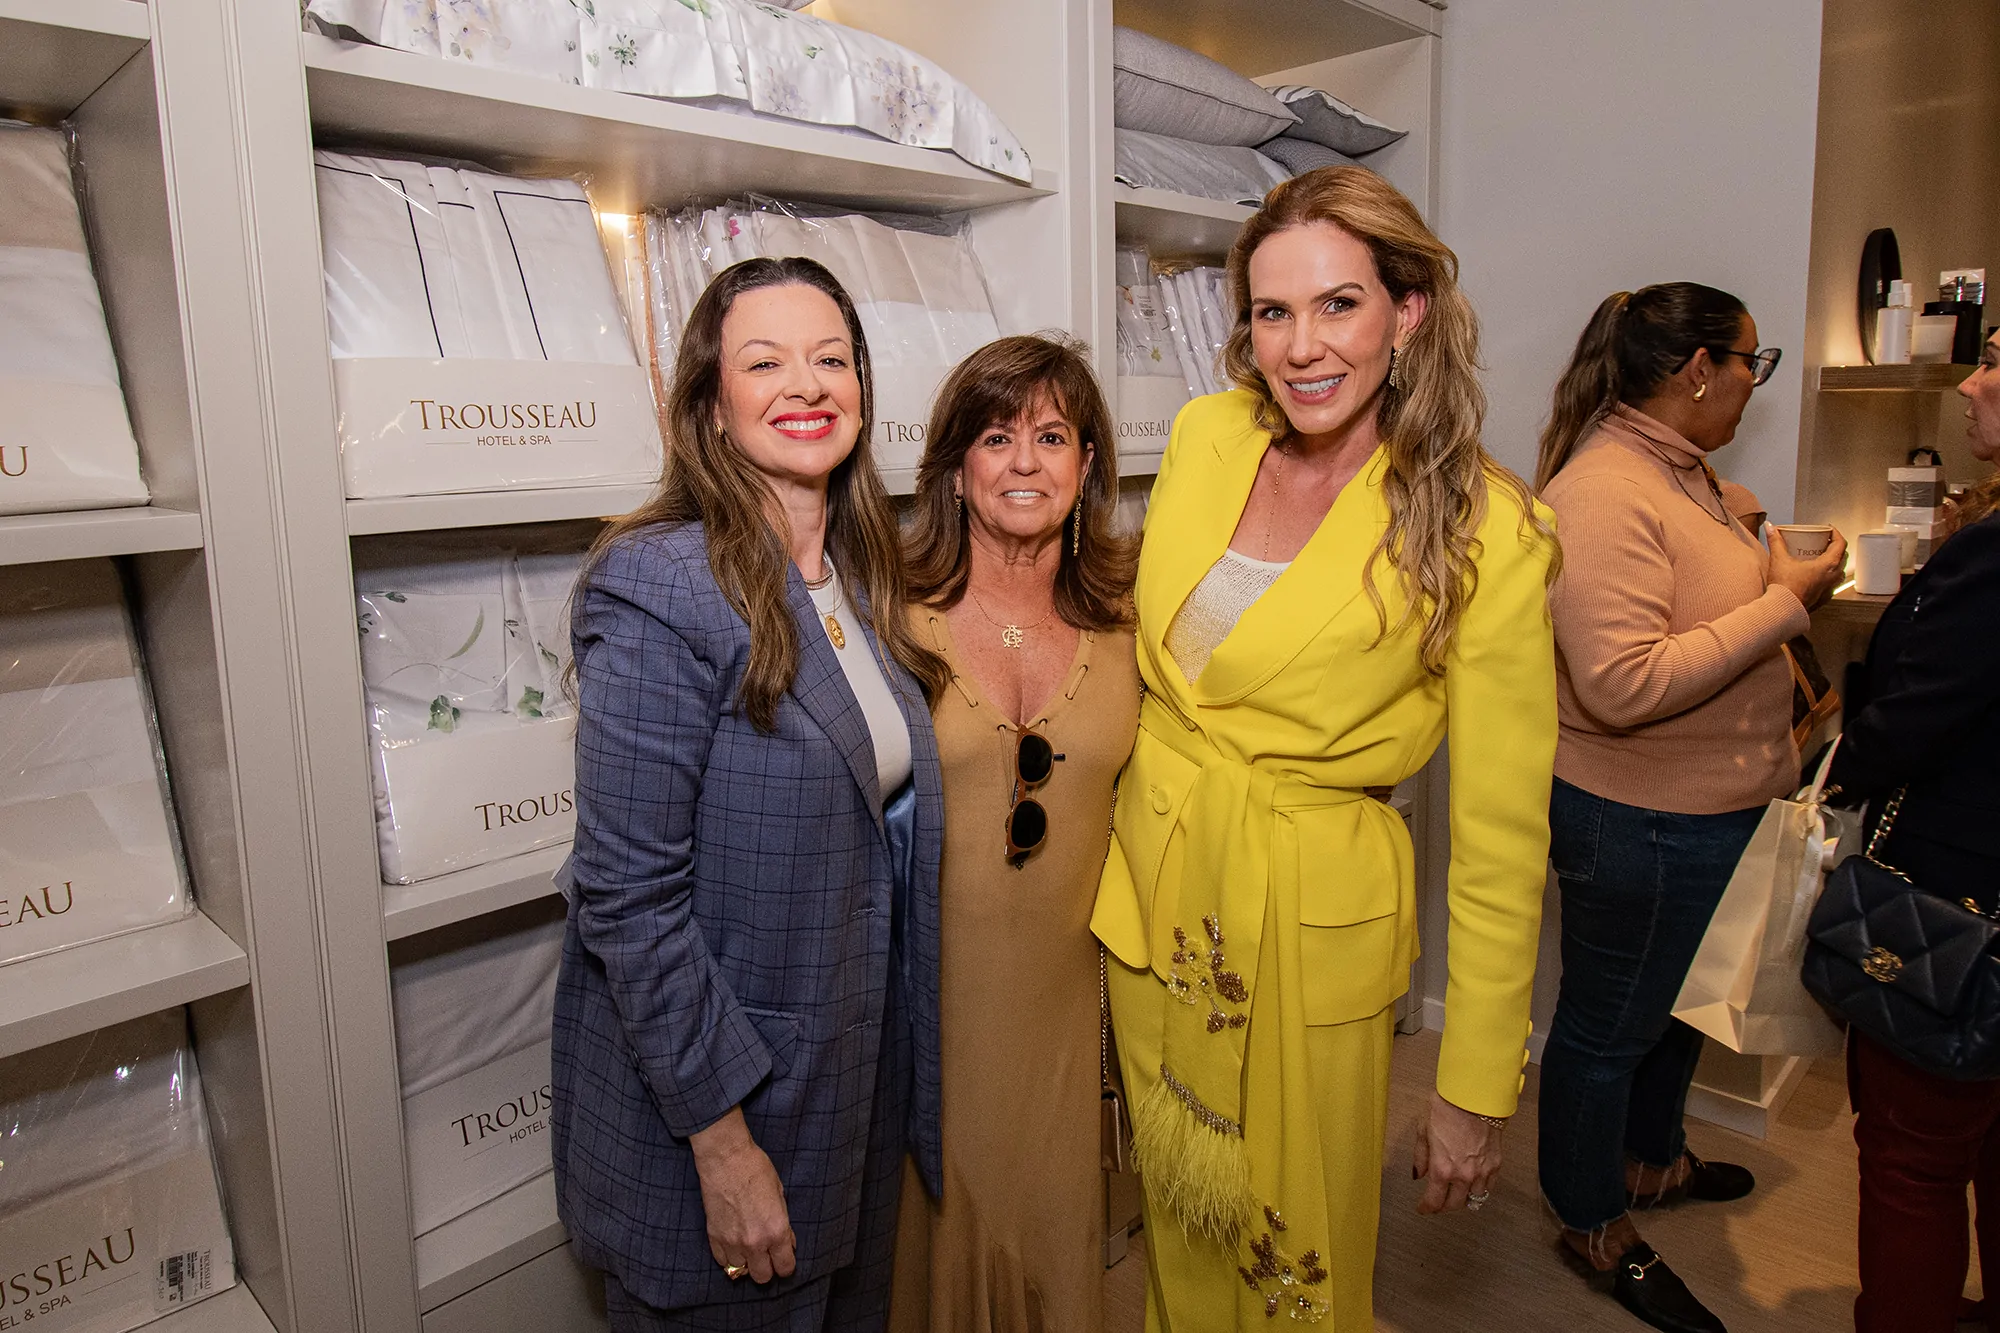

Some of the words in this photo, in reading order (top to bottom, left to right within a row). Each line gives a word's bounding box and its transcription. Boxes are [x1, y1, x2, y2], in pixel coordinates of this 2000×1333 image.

[410, 399, 597, 430] TROUSSEAU
[476, 435, 516, 447] HOTEL
[518, 436, 527, 446] &
[529, 434, 552, 446] SPA
[880, 421, 928, 443] TRO
[1117, 419, 1171, 438] OUSSEAU
[474, 789, 573, 832] TROUS
[509, 1119, 547, 1144] HOTEL
[24, 1308, 35, 1321] &
[39, 1294, 72, 1315] SPA
